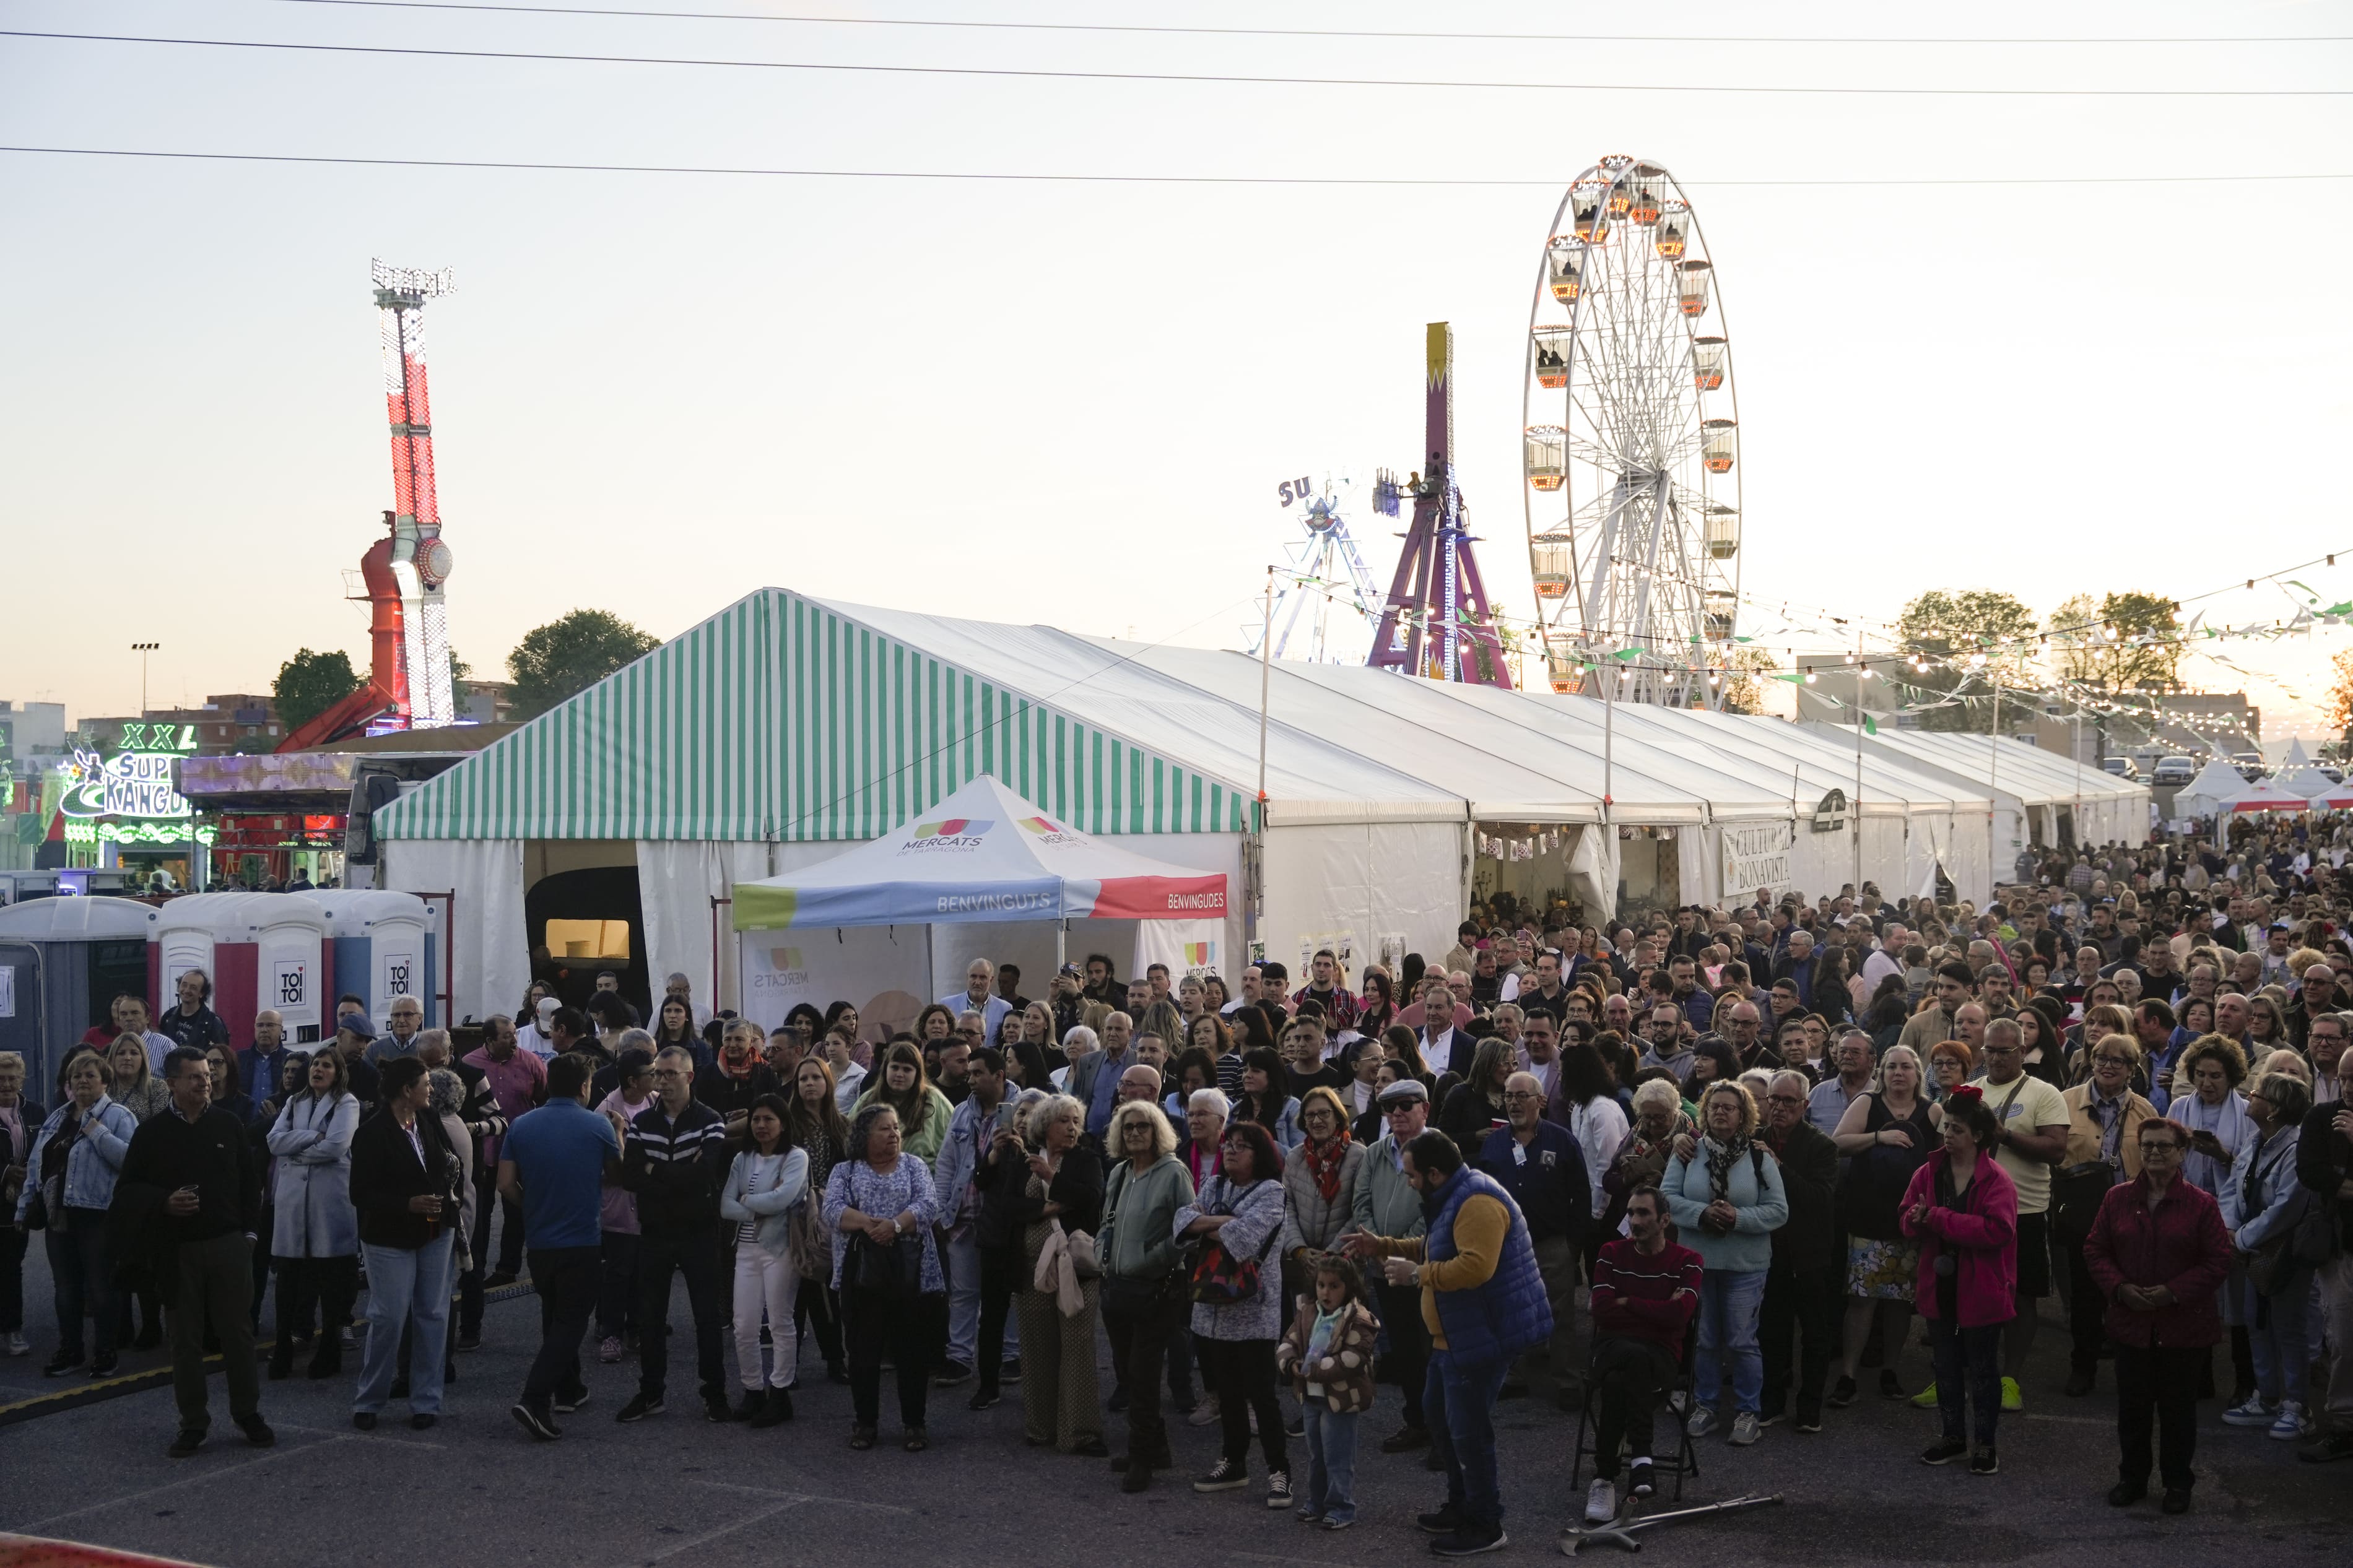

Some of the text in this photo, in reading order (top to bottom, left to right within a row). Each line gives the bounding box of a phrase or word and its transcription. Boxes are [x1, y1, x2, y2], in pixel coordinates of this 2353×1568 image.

[118, 724, 197, 750] XXL
[118, 753, 172, 779] SUP
[104, 775, 188, 815] KANGU
[902, 837, 983, 850] MERCATS
[914, 846, 975, 854] TARRAGONA
[1736, 826, 1790, 857] CULTURAL
[1738, 856, 1790, 889] BONAVISTA
[937, 893, 1051, 912] BENVINGUTS
[1168, 892, 1224, 909] BENVINGUDES
[281, 988, 302, 1003] TOI
[390, 980, 409, 995] TOI
